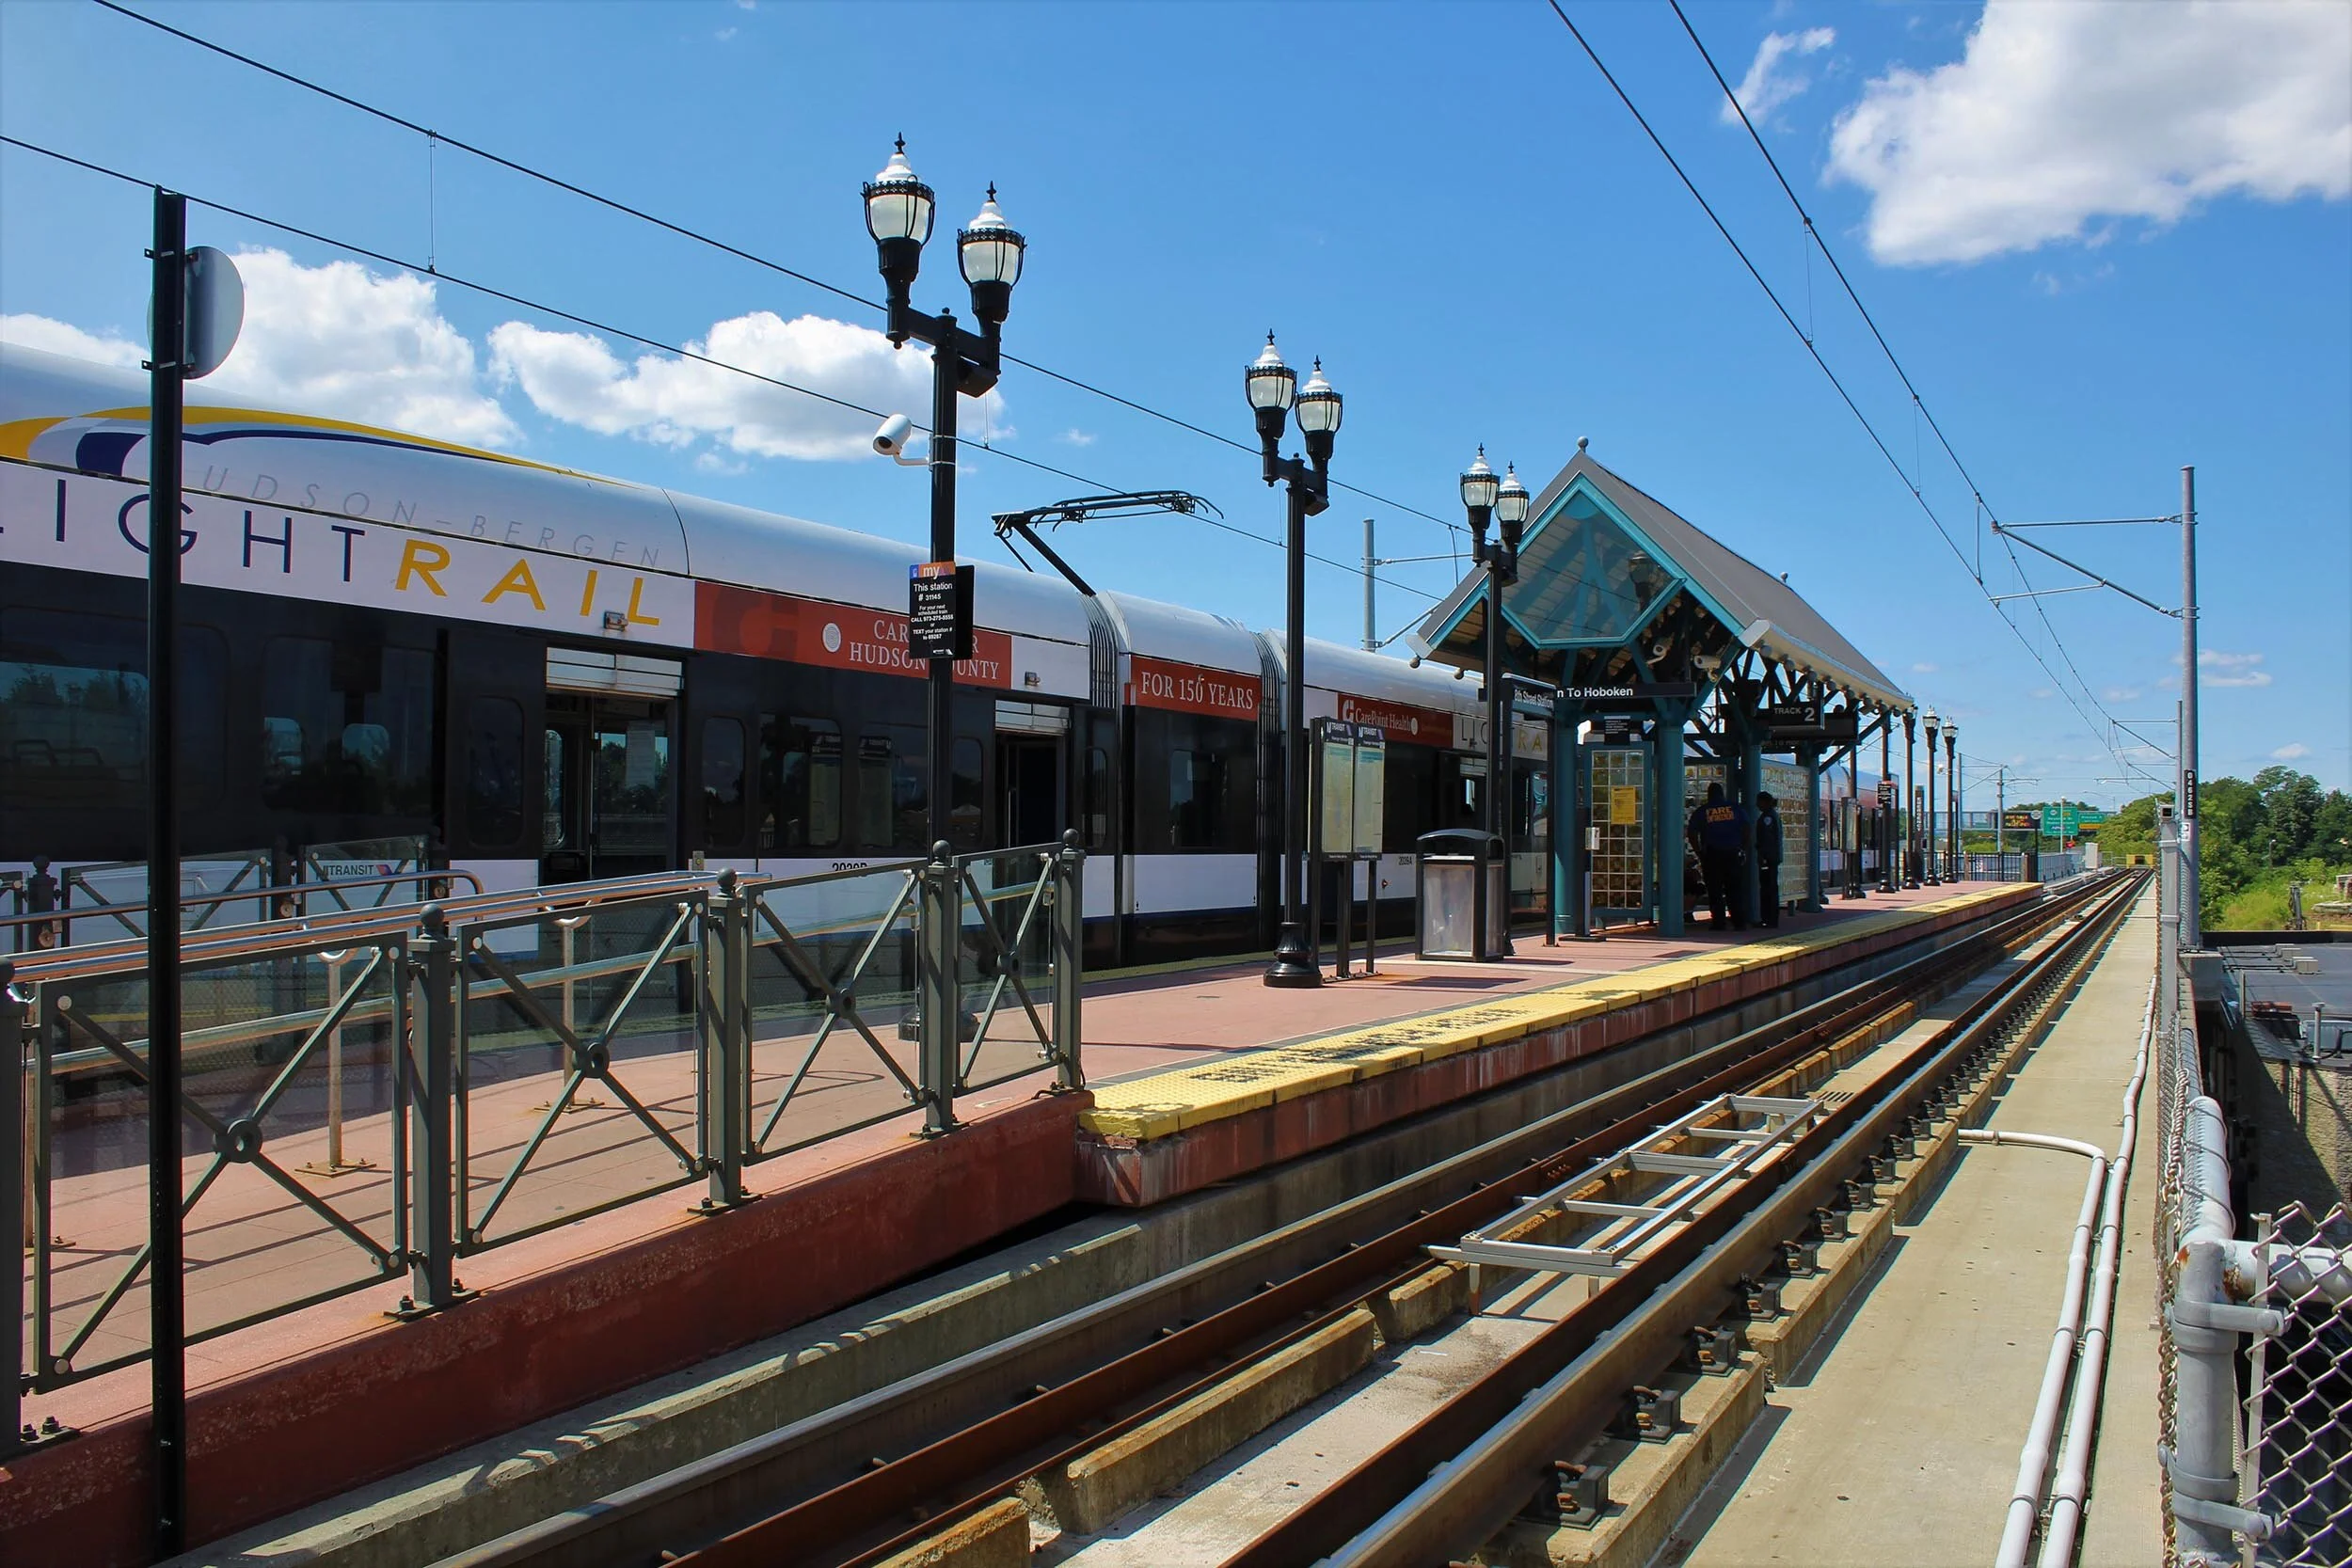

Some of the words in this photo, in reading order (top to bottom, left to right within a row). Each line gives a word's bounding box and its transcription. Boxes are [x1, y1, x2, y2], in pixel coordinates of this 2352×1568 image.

[202, 465, 660, 567] UDSON-BERGEN
[0, 479, 365, 582] IGHT
[395, 539, 660, 626] RAIL
[914, 583, 929, 592] This
[930, 581, 953, 591] station
[918, 594, 924, 602] #
[874, 619, 910, 643] CAR
[850, 641, 926, 671] HUDSON
[1142, 671, 1174, 699] FOR
[1179, 678, 1203, 704] 150
[1208, 683, 1253, 710] YEARS
[1566, 688, 1581, 698] To
[1584, 687, 1633, 697] Hoboken
[1355, 707, 1389, 728] CarePoint
[1390, 713, 1411, 731] Health
[1804, 707, 1815, 721] 2
[330, 865, 374, 876] TRANSIT
